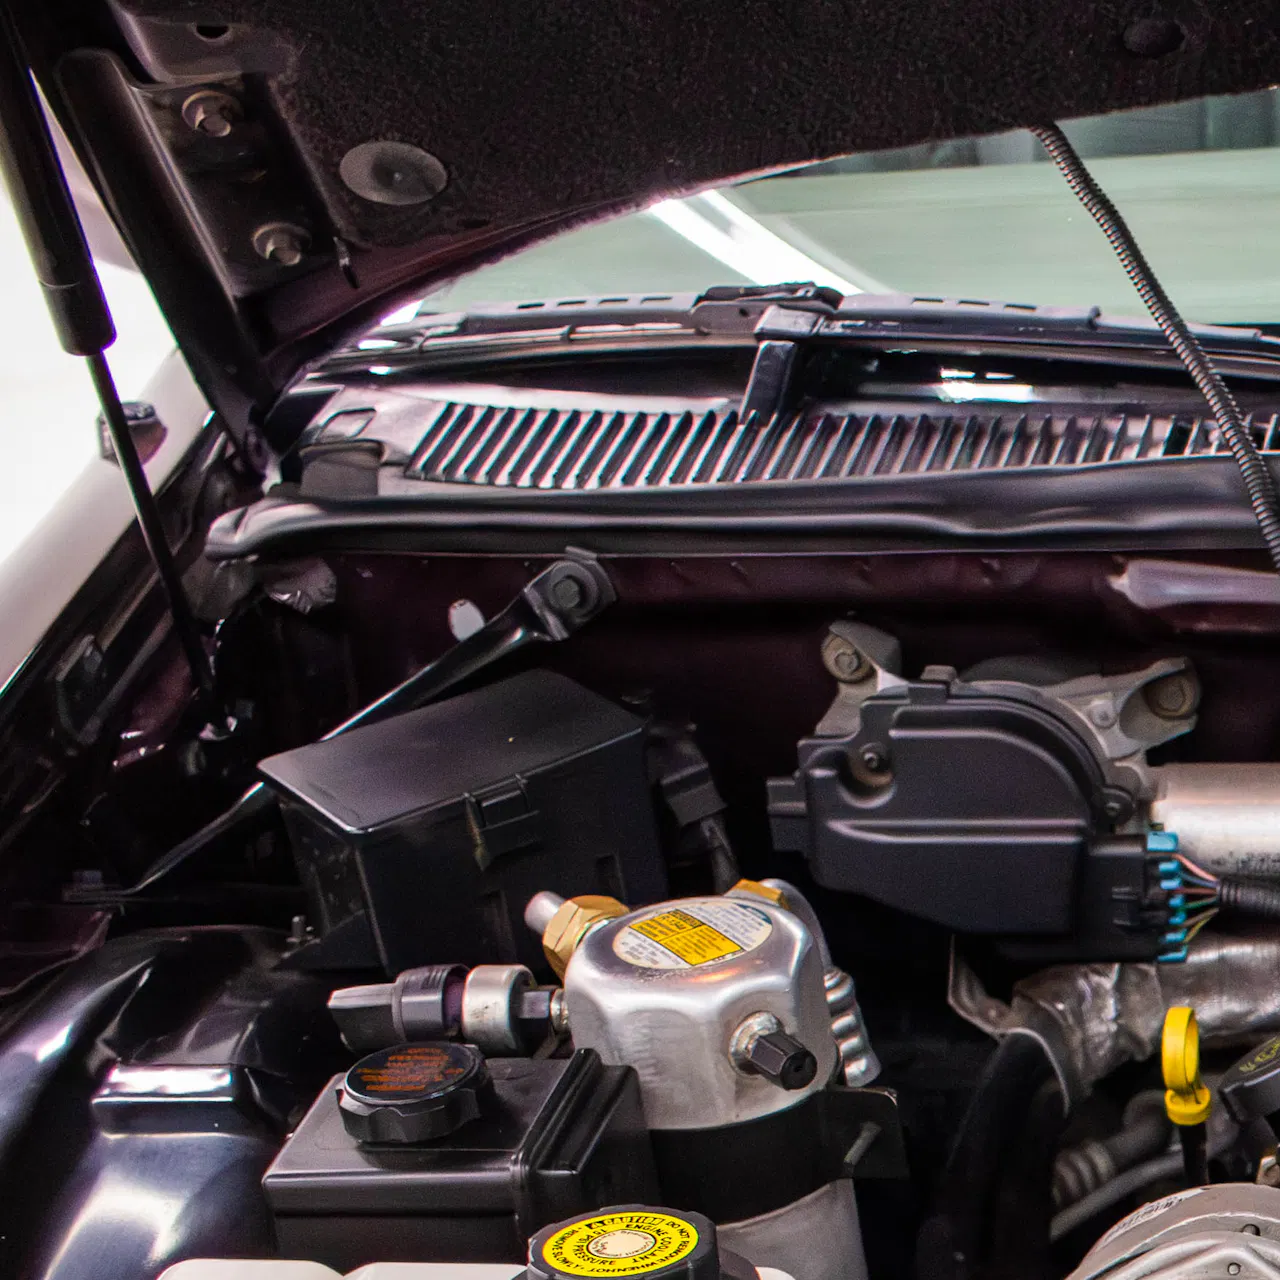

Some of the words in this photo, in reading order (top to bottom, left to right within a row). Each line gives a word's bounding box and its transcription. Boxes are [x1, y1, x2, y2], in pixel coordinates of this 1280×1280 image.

[603, 1216, 664, 1226] CAUTION
[666, 1220, 680, 1229] DO
[625, 1223, 667, 1237] ENGINE
[680, 1227, 690, 1240] NOT
[572, 1244, 617, 1266] PRESSURE
[632, 1236, 672, 1264] COOLANT
[657, 1240, 690, 1264] REMOVE
